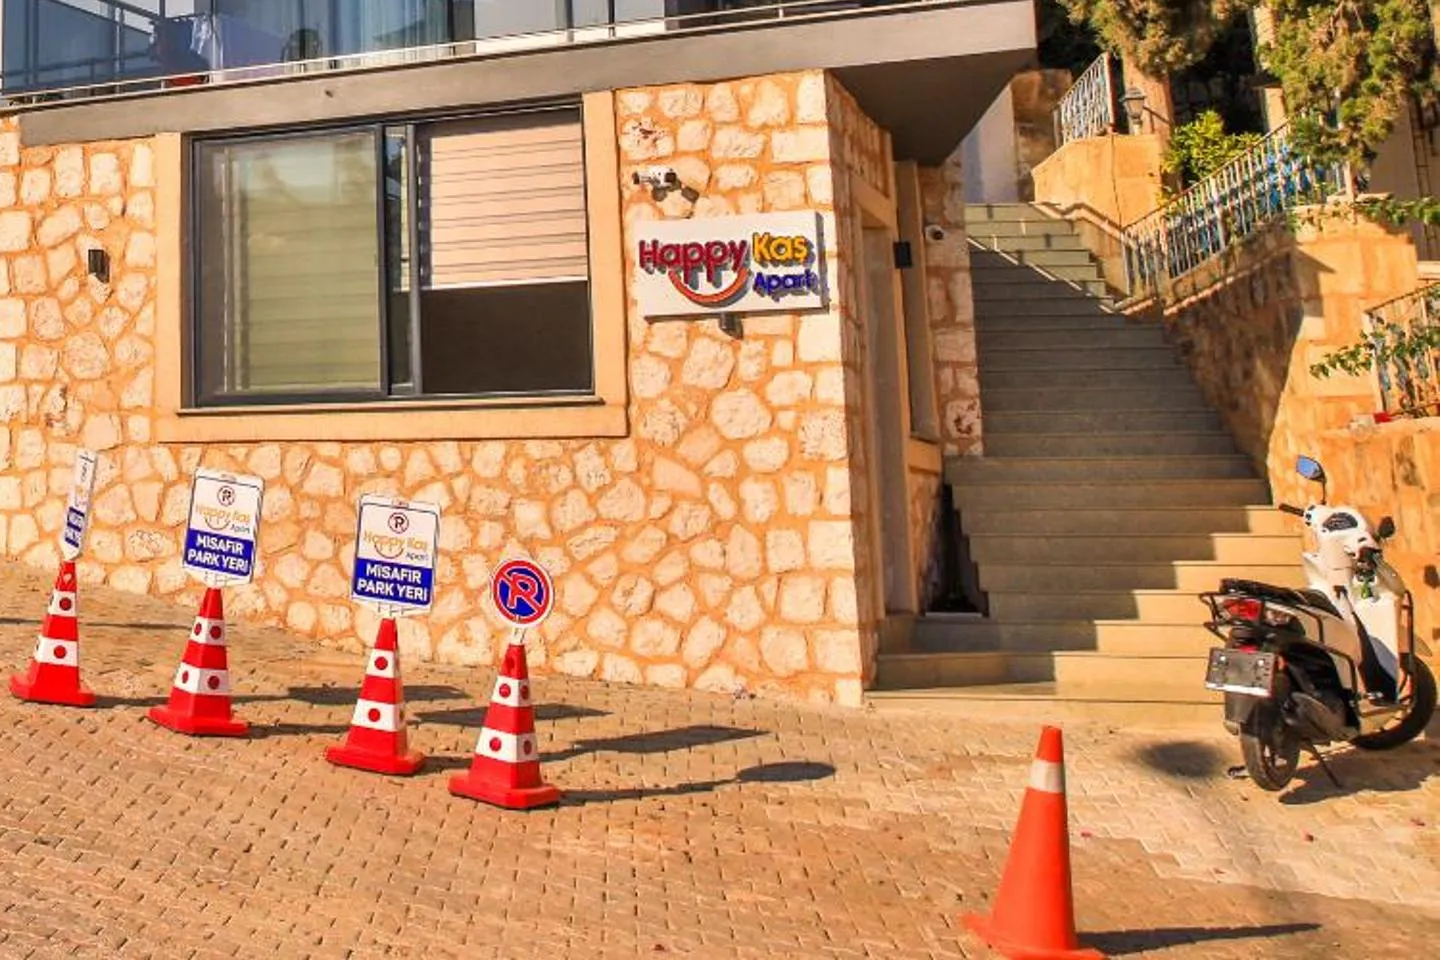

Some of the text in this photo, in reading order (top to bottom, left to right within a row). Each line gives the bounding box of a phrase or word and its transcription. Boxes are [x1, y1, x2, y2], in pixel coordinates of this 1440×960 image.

[638, 239, 748, 285] Happy
[752, 268, 819, 294] Apart
[187, 547, 222, 567] PARK
[356, 578, 394, 597] PARK
